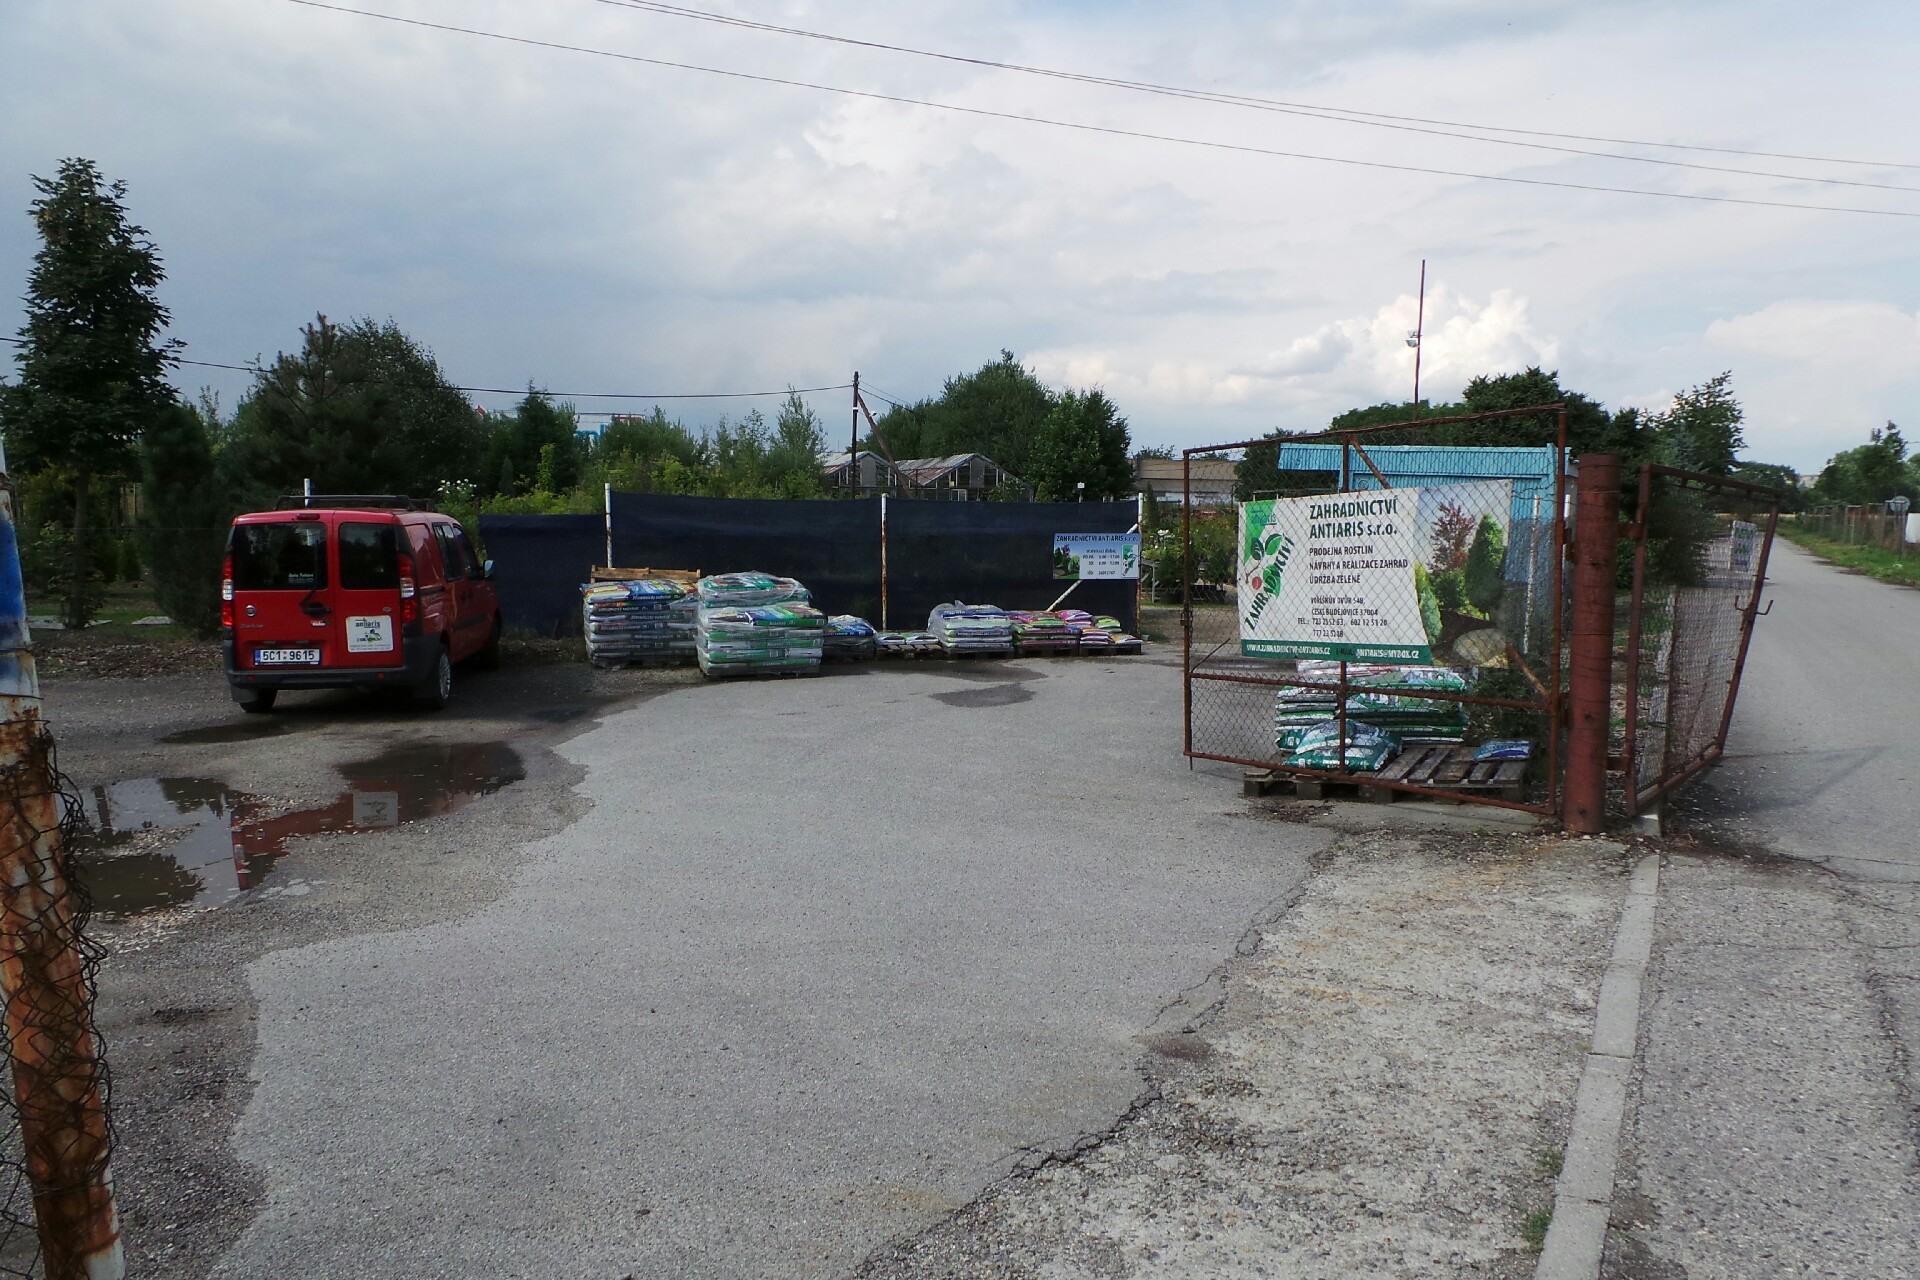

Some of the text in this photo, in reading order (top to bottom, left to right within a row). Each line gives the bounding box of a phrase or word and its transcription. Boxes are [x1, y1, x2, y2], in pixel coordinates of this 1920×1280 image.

[1309, 495, 1398, 520] ZAHRADNICTVÍ
[1309, 521, 1398, 539] ANTIARIS s.r.o.
[1309, 545, 1373, 556] PRODEJNA ROSTLIN
[1309, 559, 1408, 570] NÁVRHY A REALIZACE ZAHRAD
[1309, 574, 1335, 584] ÚDRŽBA
[262, 650, 315, 661] 5C1 9615
